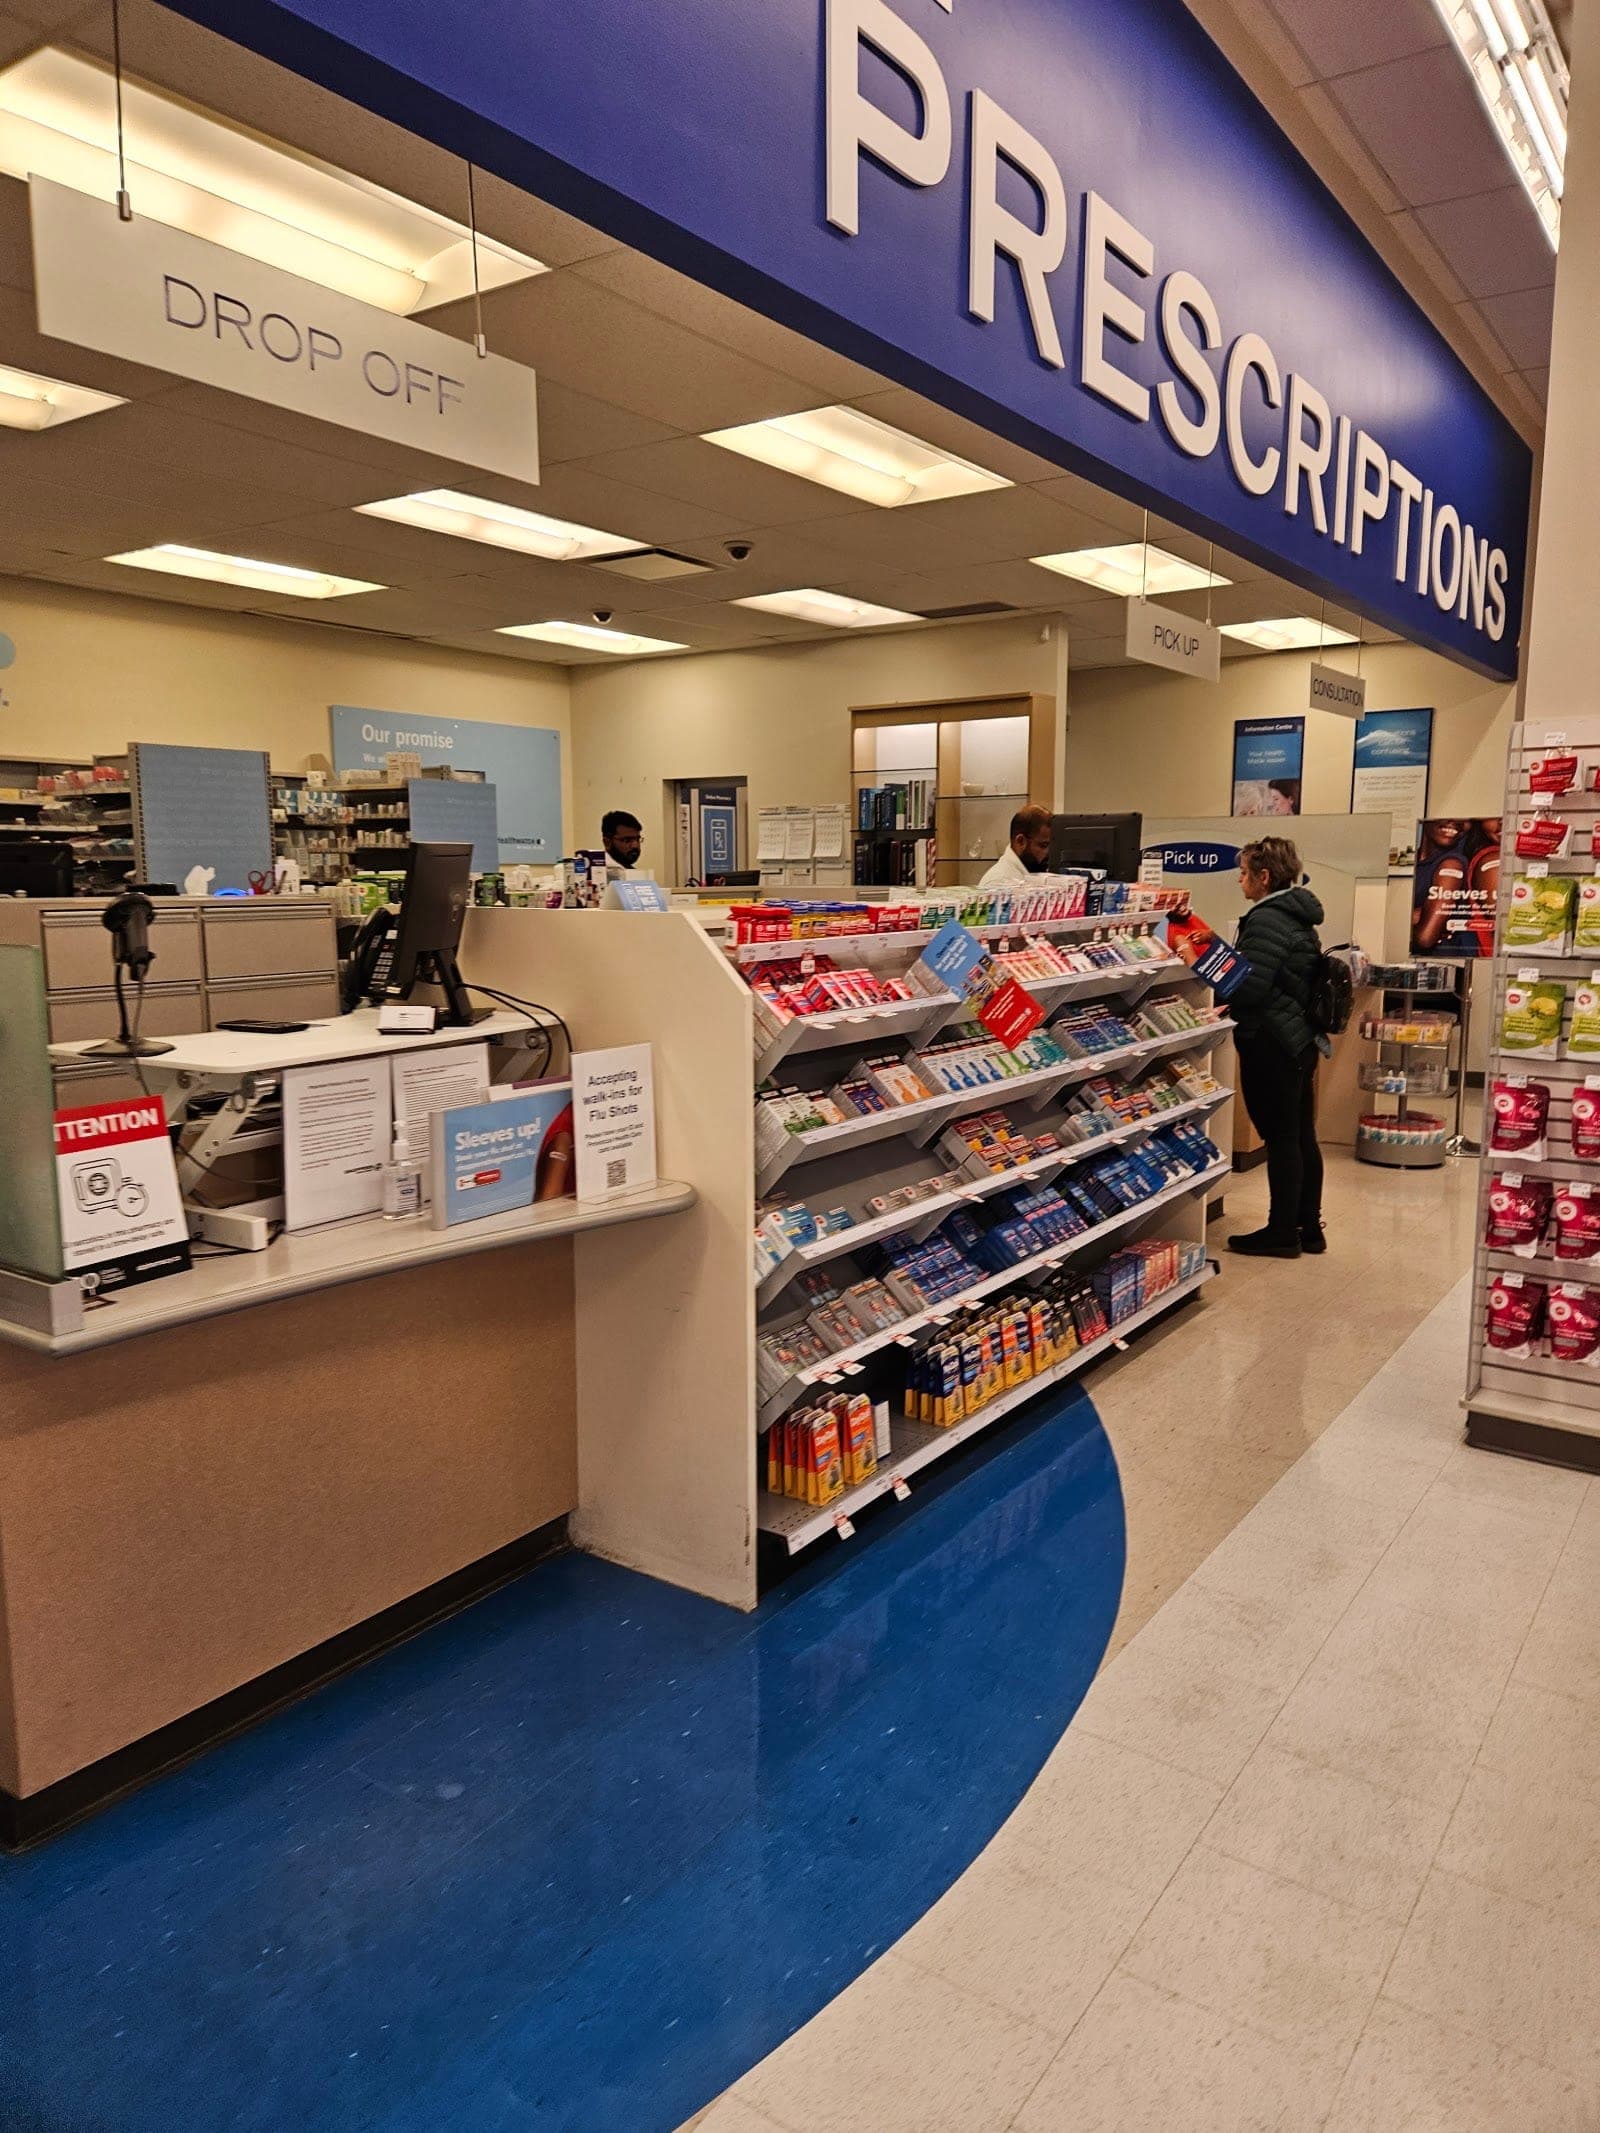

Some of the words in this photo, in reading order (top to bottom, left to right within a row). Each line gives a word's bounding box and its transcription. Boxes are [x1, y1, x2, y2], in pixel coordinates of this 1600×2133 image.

[825, 0, 1508, 642] PRESCRIPTIONS
[162, 273, 343, 372] DROP
[362, 350, 466, 416] OFF
[1153, 624, 1181, 652] PICK
[1183, 635, 1200, 657] UP
[1313, 677, 1364, 708] CONSULTATION
[361, 723, 391, 744] Our
[395, 731, 454, 749] promise
[1164, 850, 1195, 865] Pick
[1200, 853, 1219, 868] up
[1427, 886, 1488, 900] Sleeves
[587, 1070, 638, 1087] Accepting
[582, 1088, 626, 1105] walk-ins
[628, 1084, 644, 1097] for
[53, 1107, 159, 1142] TTENTION
[589, 1109, 606, 1122] Flu
[609, 1103, 639, 1118] Shots
[455, 1127, 515, 1151] Sleeves
[517, 1116, 542, 1140] up!
